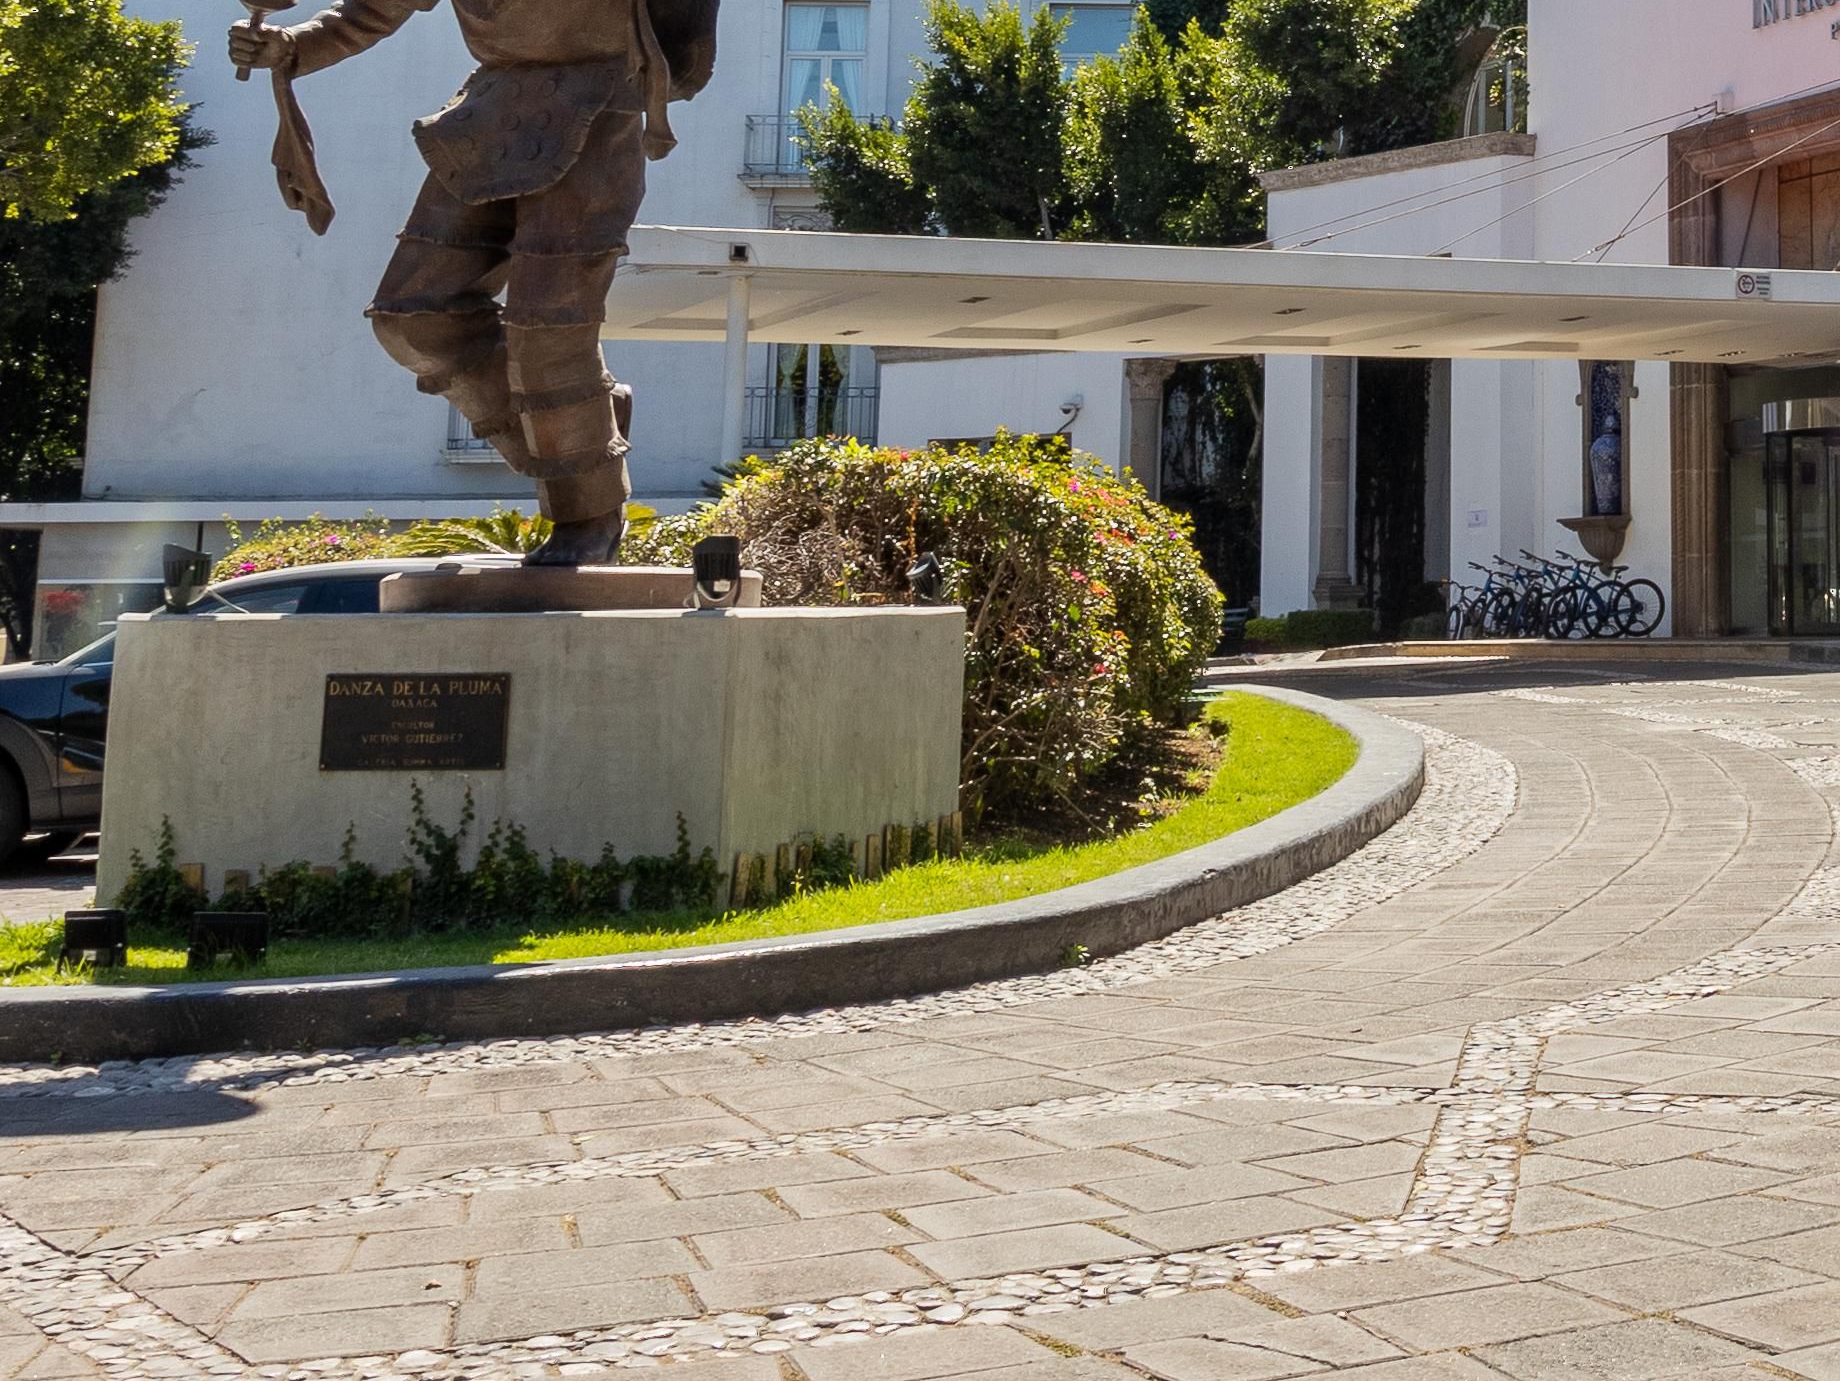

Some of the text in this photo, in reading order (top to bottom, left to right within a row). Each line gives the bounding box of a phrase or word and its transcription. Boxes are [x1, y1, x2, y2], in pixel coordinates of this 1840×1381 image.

[329, 680, 503, 696] DANZA DE LA PLUMA
[391, 698, 438, 709] OAXACA
[361, 733, 400, 745] VICTOR
